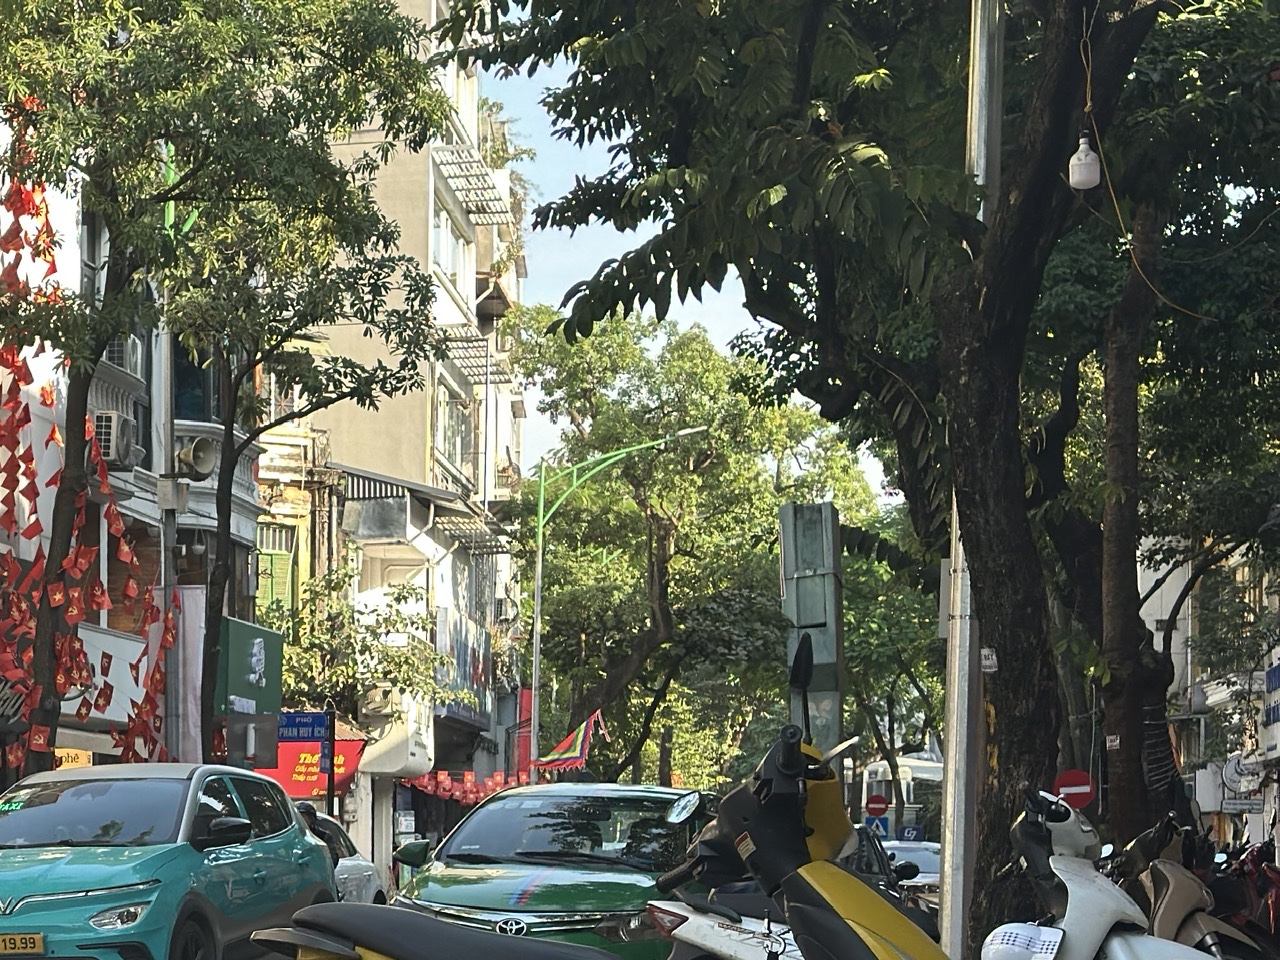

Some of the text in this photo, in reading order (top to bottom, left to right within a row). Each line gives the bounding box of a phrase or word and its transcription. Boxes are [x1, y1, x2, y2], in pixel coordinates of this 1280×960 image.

[279, 724, 325, 737] PHAN HUY ÍCH
